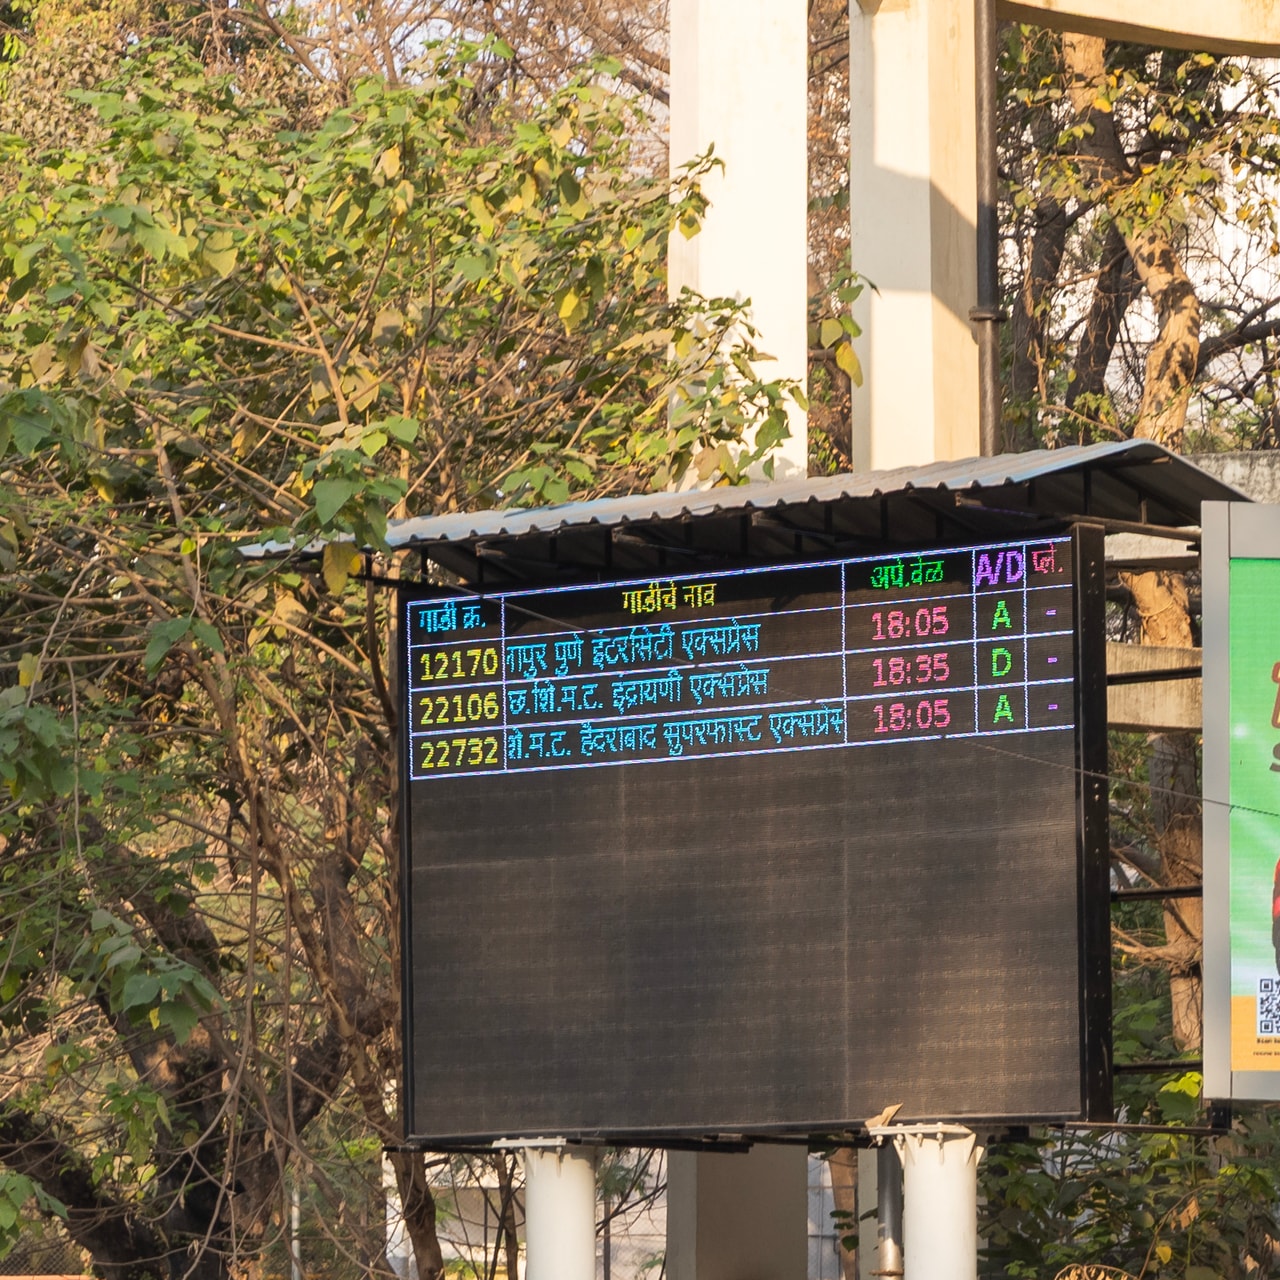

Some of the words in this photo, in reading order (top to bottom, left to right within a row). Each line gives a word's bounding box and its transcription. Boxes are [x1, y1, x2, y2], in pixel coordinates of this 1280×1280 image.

[974, 551, 1024, 586] A/D
[622, 580, 677, 613] गाडीचे
[682, 584, 717, 608] नाव
[419, 601, 456, 632] गाडी
[462, 606, 486, 629] क्र.
[871, 606, 949, 640] 18:05
[992, 601, 1012, 629] A
[420, 648, 498, 680] 12170
[555, 633, 584, 677] पुणे
[681, 617, 761, 659] एक्सप्रेस
[689, 663, 770, 705] एक्सप्रेस
[872, 653, 949, 687] 18:35
[992, 648, 1012, 677] D
[419, 692, 499, 724] 22106
[873, 699, 950, 733] 18:05
[993, 695, 1014, 723] A
[420, 736, 498, 768] 22732
[663, 715, 762, 756] सुपरफास्ट
